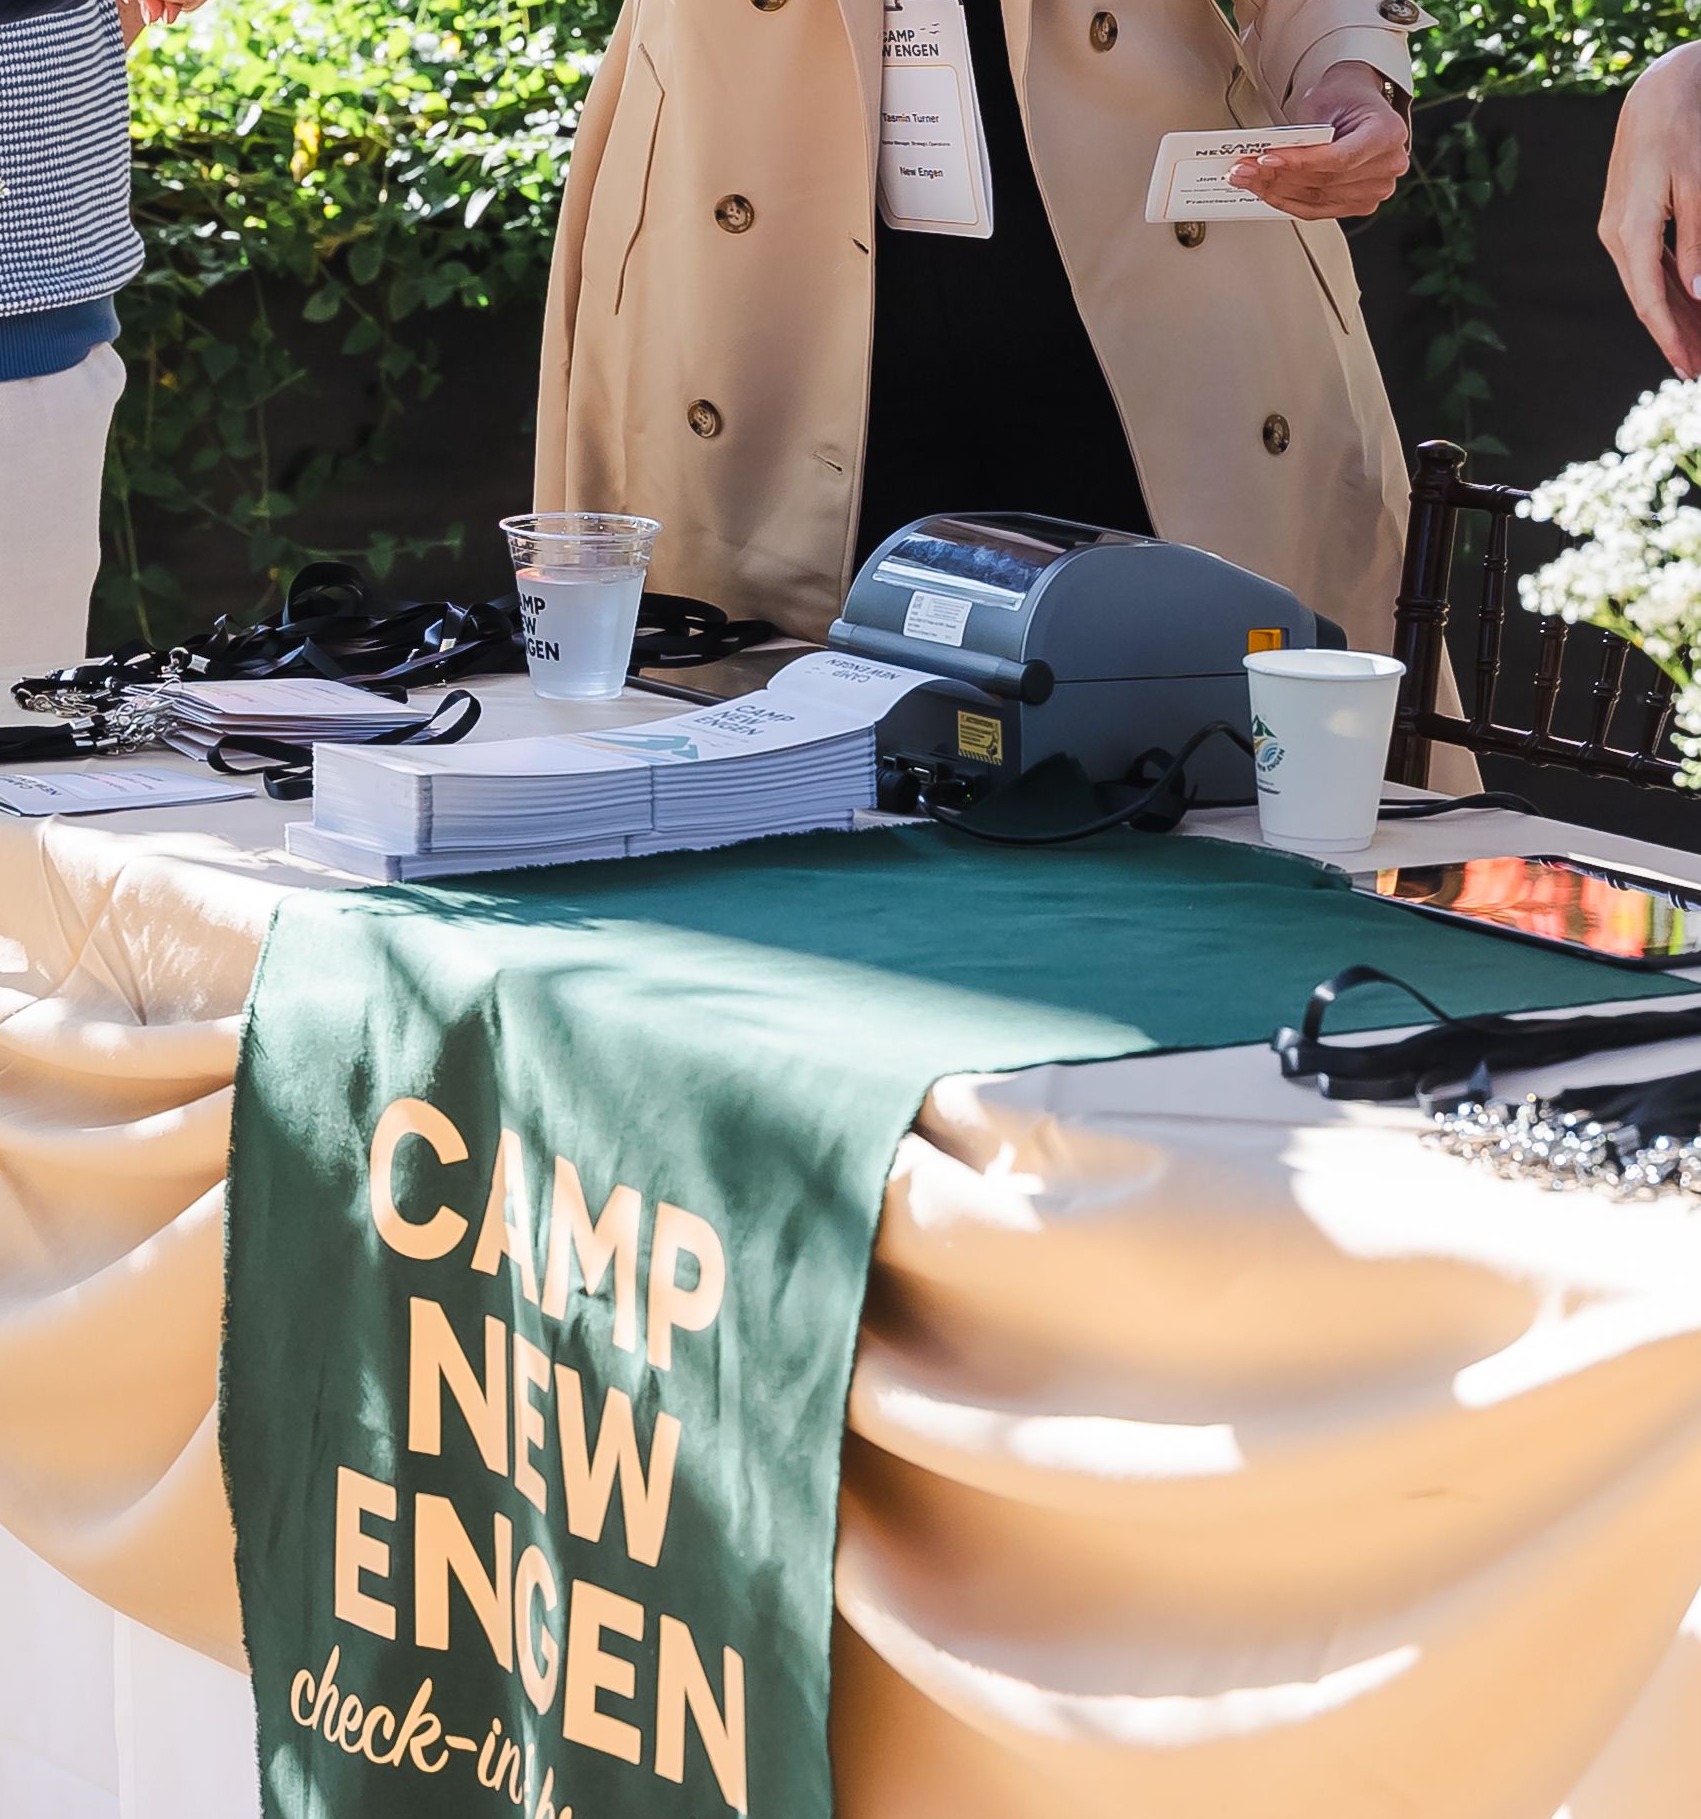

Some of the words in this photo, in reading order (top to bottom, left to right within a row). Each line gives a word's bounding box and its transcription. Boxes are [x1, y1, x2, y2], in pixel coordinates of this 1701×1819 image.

[895, 43, 939, 57] ENGEN
[1221, 142, 1271, 151] CAMP
[918, 167, 944, 179] Engen
[712, 710, 766, 725] NEW
[735, 705, 796, 722] CAMP
[693, 716, 764, 736] ENGEN
[369, 1098, 726, 1372] CAMP
[408, 1296, 682, 1568] NEW
[334, 1465, 748, 1816] ENGEN
